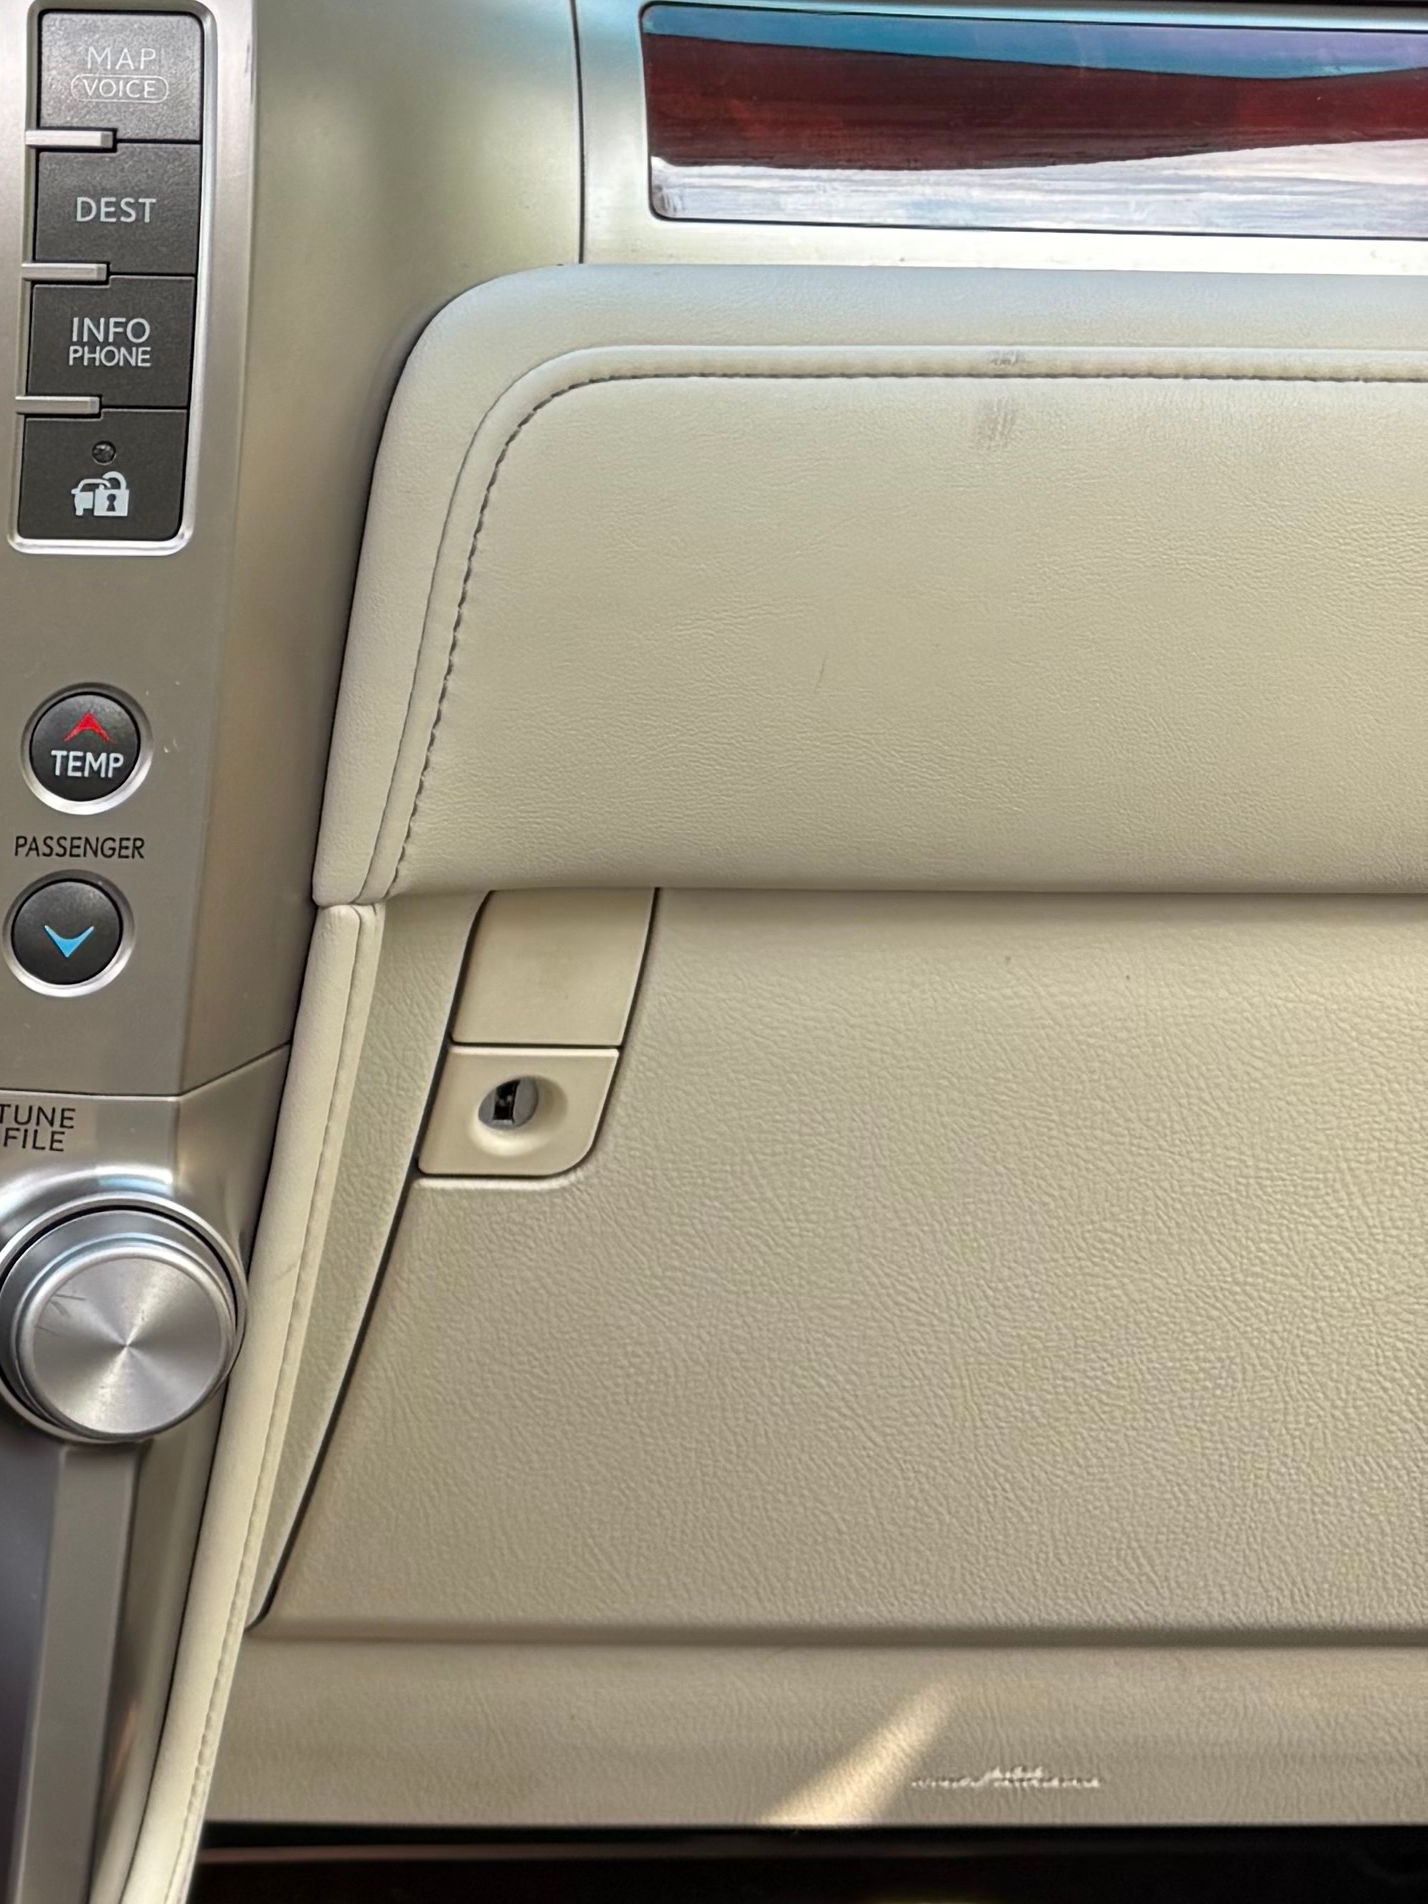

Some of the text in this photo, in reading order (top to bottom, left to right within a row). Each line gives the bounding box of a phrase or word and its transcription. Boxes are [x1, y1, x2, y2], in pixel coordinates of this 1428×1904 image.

[85, 45, 156, 69] MAP
[82, 78, 158, 99] VOICE
[76, 196, 157, 223] DEST
[72, 316, 151, 344] INFO
[68, 345, 152, 367] PHONE
[50, 750, 125, 779] TEMP
[14, 835, 145, 860] PASSENGER
[2, 1125, 67, 1153] FILE
